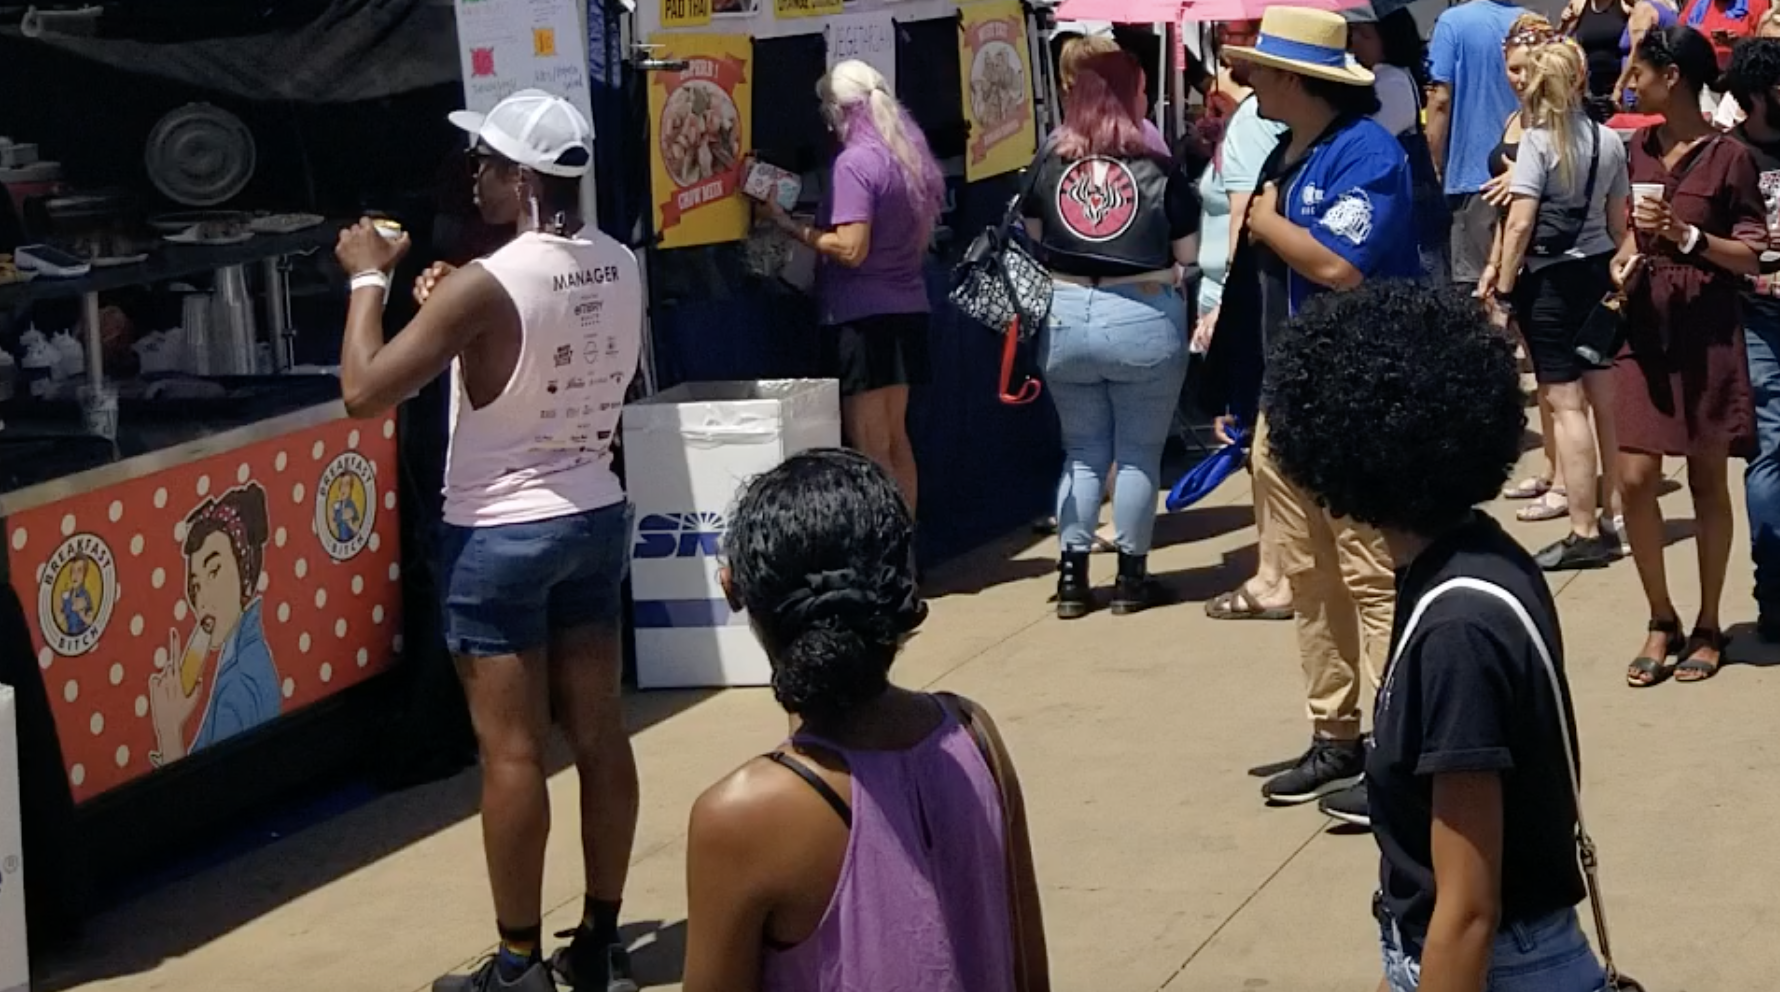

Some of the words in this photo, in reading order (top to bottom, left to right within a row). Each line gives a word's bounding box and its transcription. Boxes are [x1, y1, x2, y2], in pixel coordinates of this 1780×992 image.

[552, 265, 620, 292] MANAGER
[320, 452, 374, 498] BREAKFAST
[330, 535, 366, 555] BITCH
[43, 535, 112, 586] BREAKFAST
[58, 626, 99, 651] BITCH
